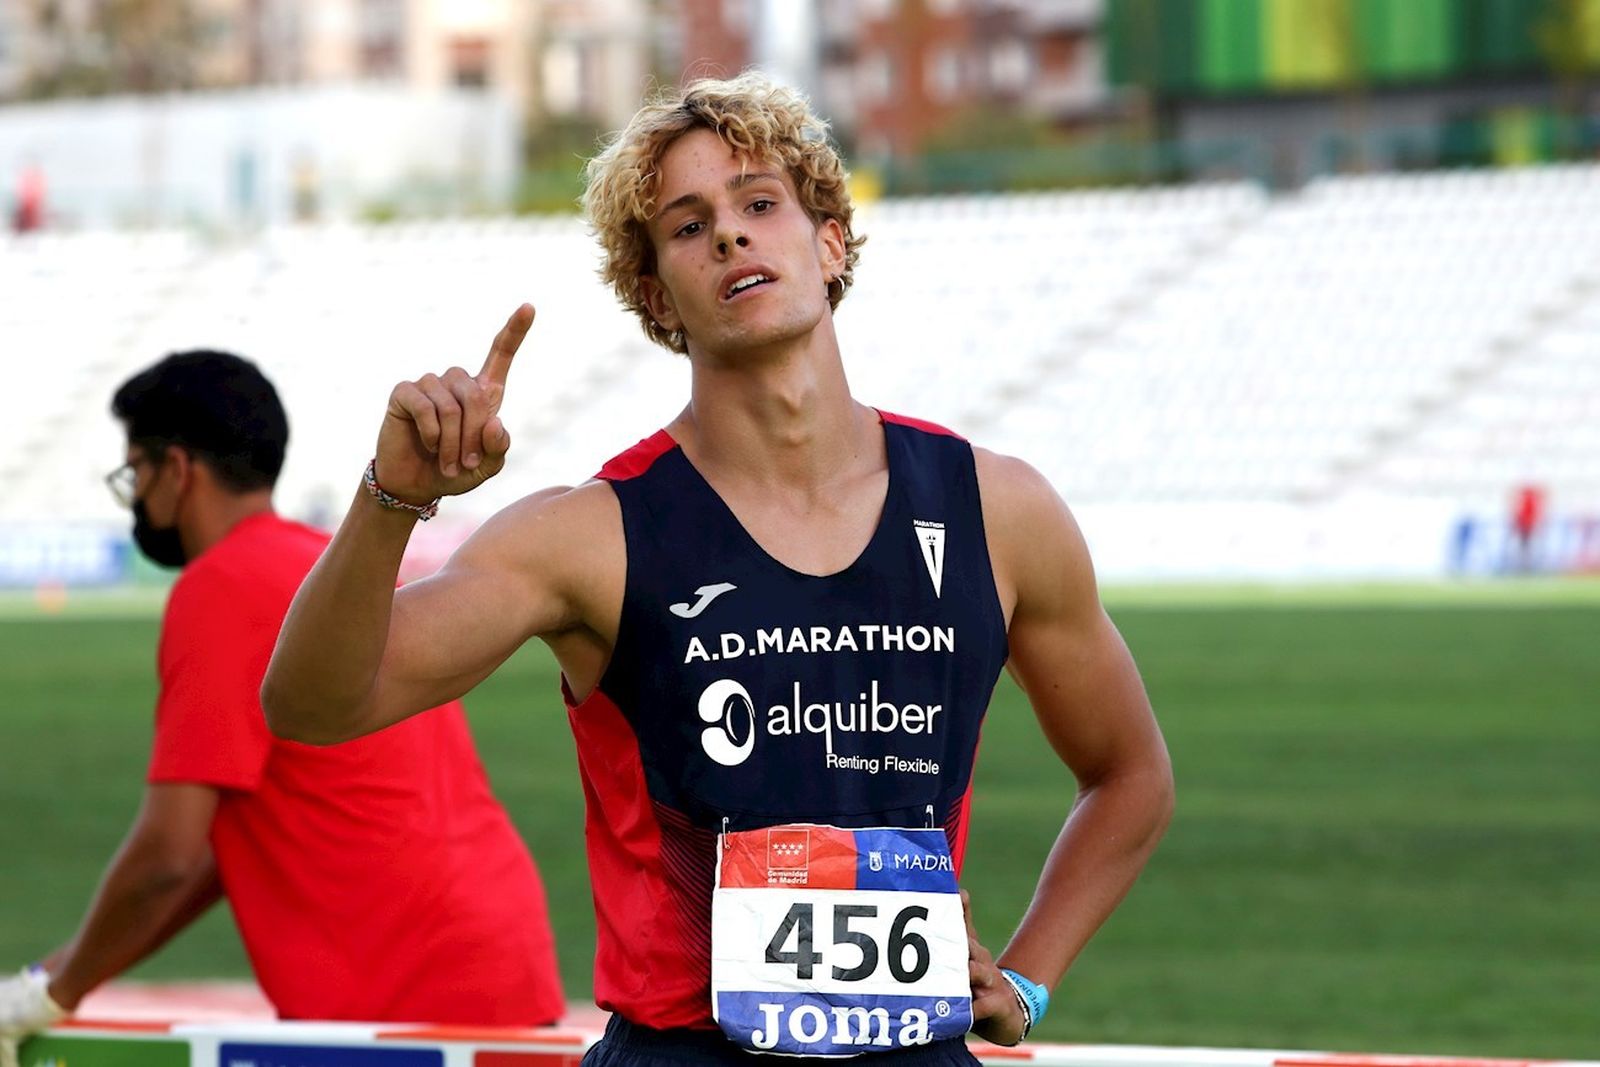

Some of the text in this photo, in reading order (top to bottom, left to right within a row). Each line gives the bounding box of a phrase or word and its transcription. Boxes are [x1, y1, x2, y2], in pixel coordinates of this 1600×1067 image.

[913, 519, 945, 528] MARATHON
[684, 625, 955, 664] A.D.MARATHON
[767, 680, 942, 753] alquiber
[826, 753, 940, 775] Renting Flexible
[779, 876, 807, 884] Madrid
[765, 902, 930, 983] 456
